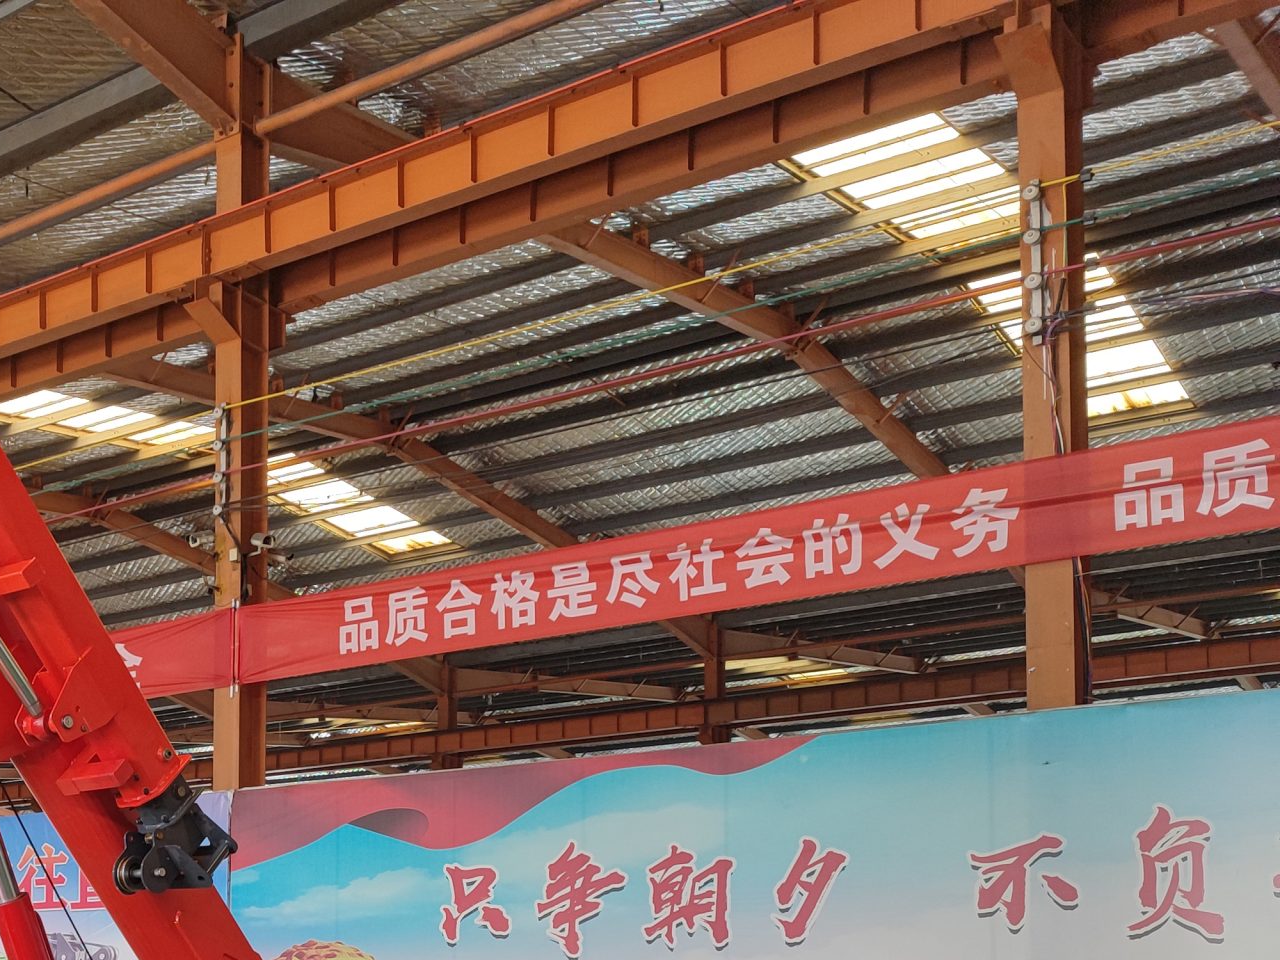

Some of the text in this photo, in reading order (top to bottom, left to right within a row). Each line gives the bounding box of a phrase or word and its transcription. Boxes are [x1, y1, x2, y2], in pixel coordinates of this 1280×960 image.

[339, 438, 1278, 655] 品质合格是尽社会的义务 品质
[437, 803, 1280, 960] 只争朝夕 不负
